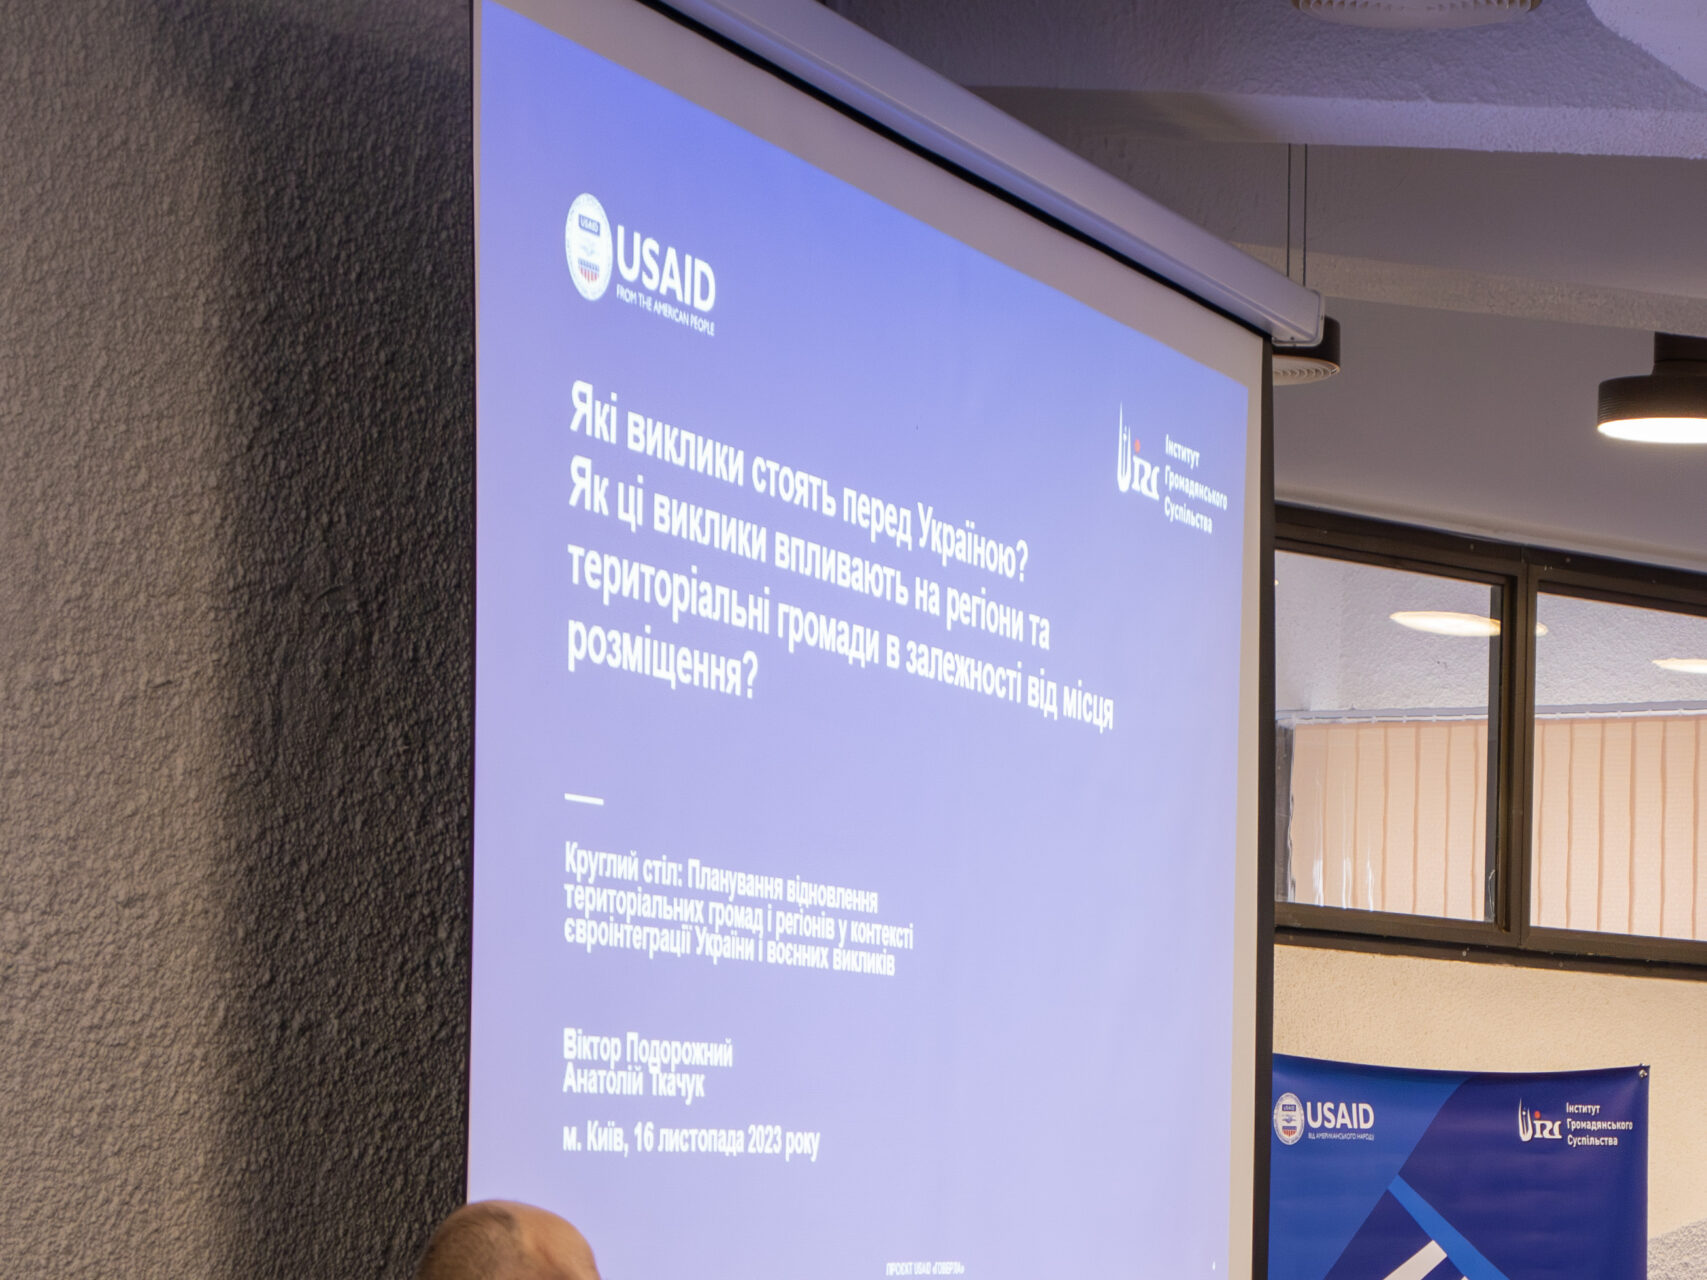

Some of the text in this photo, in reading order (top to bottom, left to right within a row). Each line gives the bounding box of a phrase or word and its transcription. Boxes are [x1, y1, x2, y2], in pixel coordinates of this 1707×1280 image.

[617, 225, 716, 312] USAID
[617, 283, 714, 336] FROM THE AMERICAN PEOPLE
[1165, 434, 1200, 470] Інститут
[568, 379, 1028, 583] Які виклики стоять перед Україною?
[1165, 465, 1228, 511] Громадянського
[1164, 496, 1213, 534] Суспільства
[567, 454, 1050, 650] Як ці виклики впливають на регіони та
[567, 543, 1114, 734] територіальні громади в залежності від місця
[567, 618, 758, 700] розміщення?
[565, 841, 879, 914] Круглий стіл: Планування відновлення
[564, 883, 914, 950] територіальних громад і регіонів у контексті
[564, 916, 896, 977] євроінтеграції України і воєнних викликів
[563, 1028, 733, 1073] Віктор Подорожний
[563, 1061, 705, 1106] Анатолій Ткачук
[1307, 1101, 1374, 1129] USAID
[1566, 1102, 1600, 1115] Інститут
[1566, 1118, 1633, 1131] Громадянського
[563, 1120, 820, 1162] м. Київ, 16 листопада 2023 року
[1568, 1135, 1618, 1147] Суспільства
